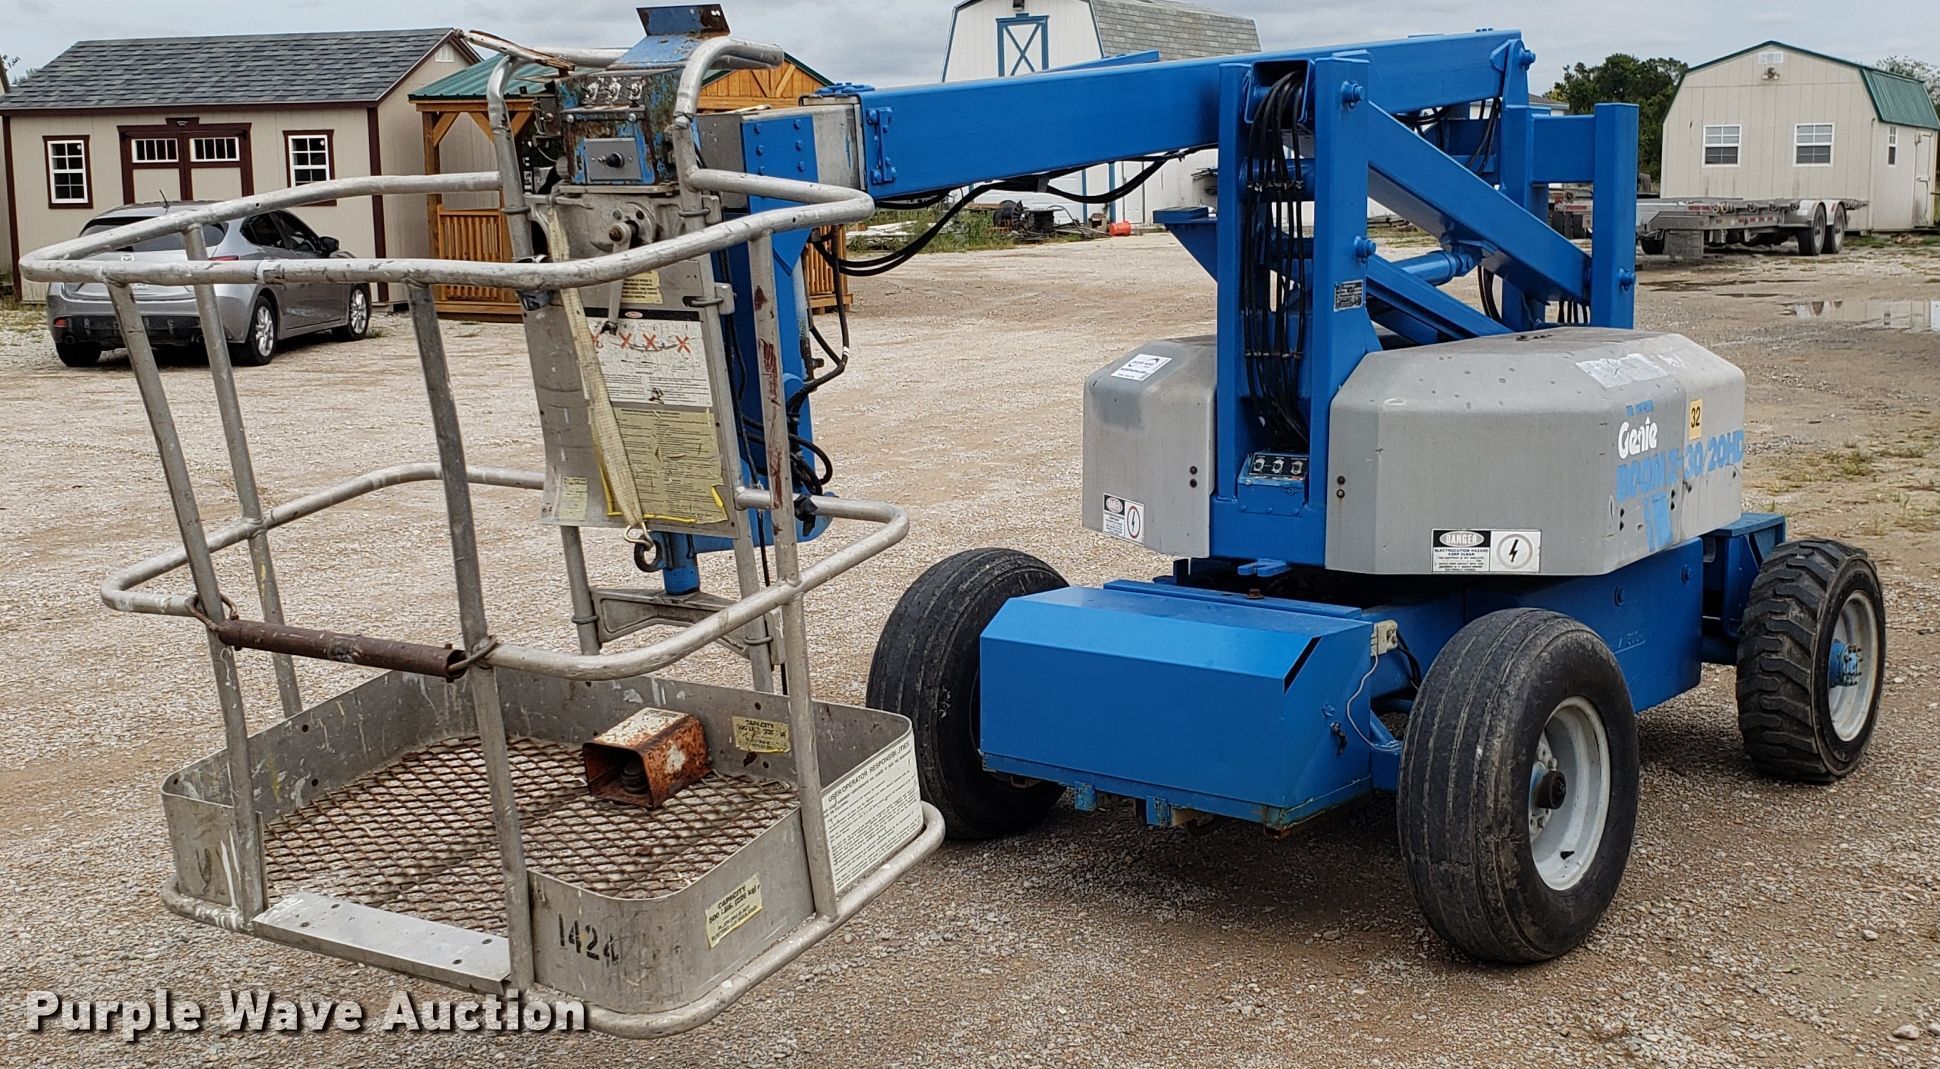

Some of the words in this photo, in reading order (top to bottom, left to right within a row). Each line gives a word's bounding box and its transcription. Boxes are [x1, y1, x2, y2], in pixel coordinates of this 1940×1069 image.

[1690, 406, 1701, 428] 32
[1618, 416, 1658, 459] Genie
[1446, 534, 1477, 543] DANGER
[558, 913, 619, 963] 1424
